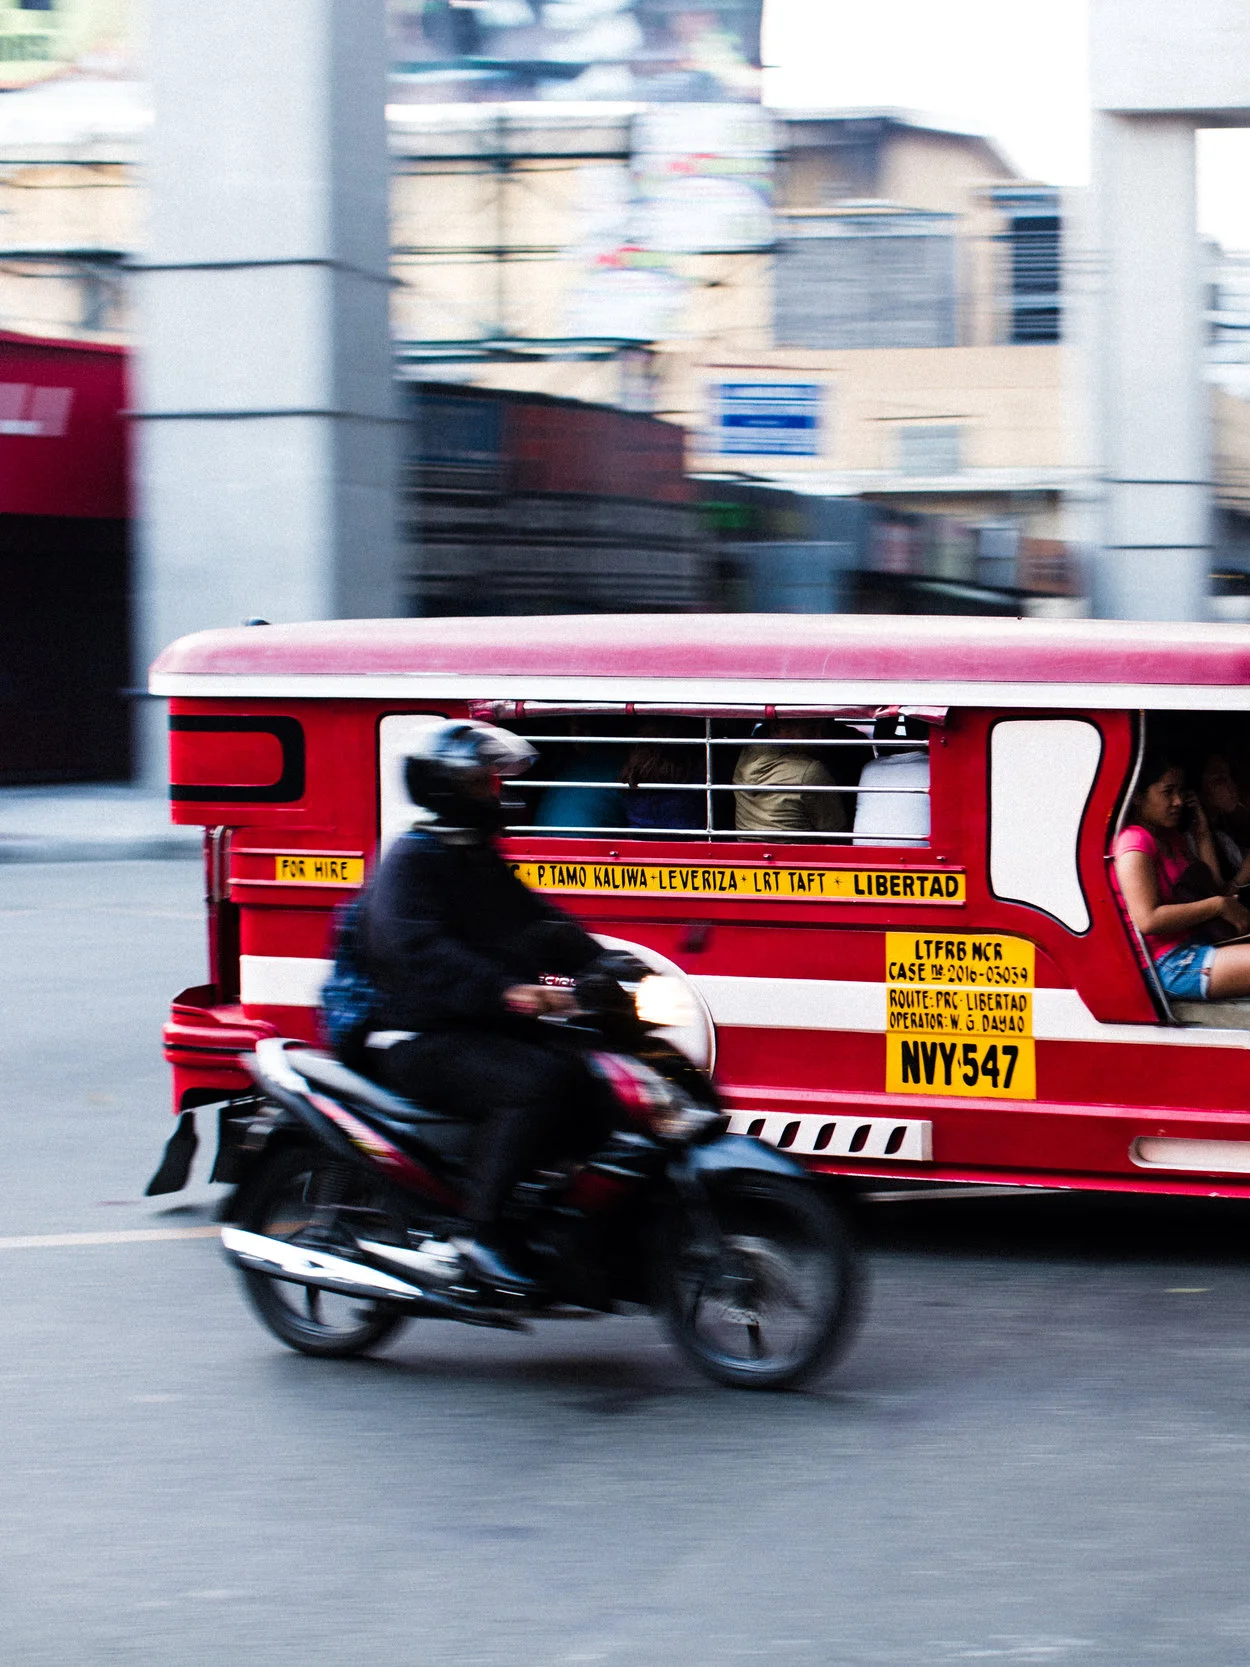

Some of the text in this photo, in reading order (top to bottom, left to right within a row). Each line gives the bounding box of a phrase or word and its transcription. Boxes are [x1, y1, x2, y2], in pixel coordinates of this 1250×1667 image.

[282, 859, 348, 880] FOR HIRE
[594, 866, 648, 889] KALIWA
[658, 869, 738, 892] LEVERIZA
[753, 871, 780, 893] LRT
[788, 872, 826, 893] TAFT
[854, 873, 959, 898] LIBERTAD
[915, 939, 1003, 962] LTFRB NCR
[888, 962, 926, 981] CASE
[966, 993, 1027, 1012] LIBERTAD
[890, 1011, 948, 1030] OPERATOR:
[982, 1014, 1025, 1033] DAYAO
